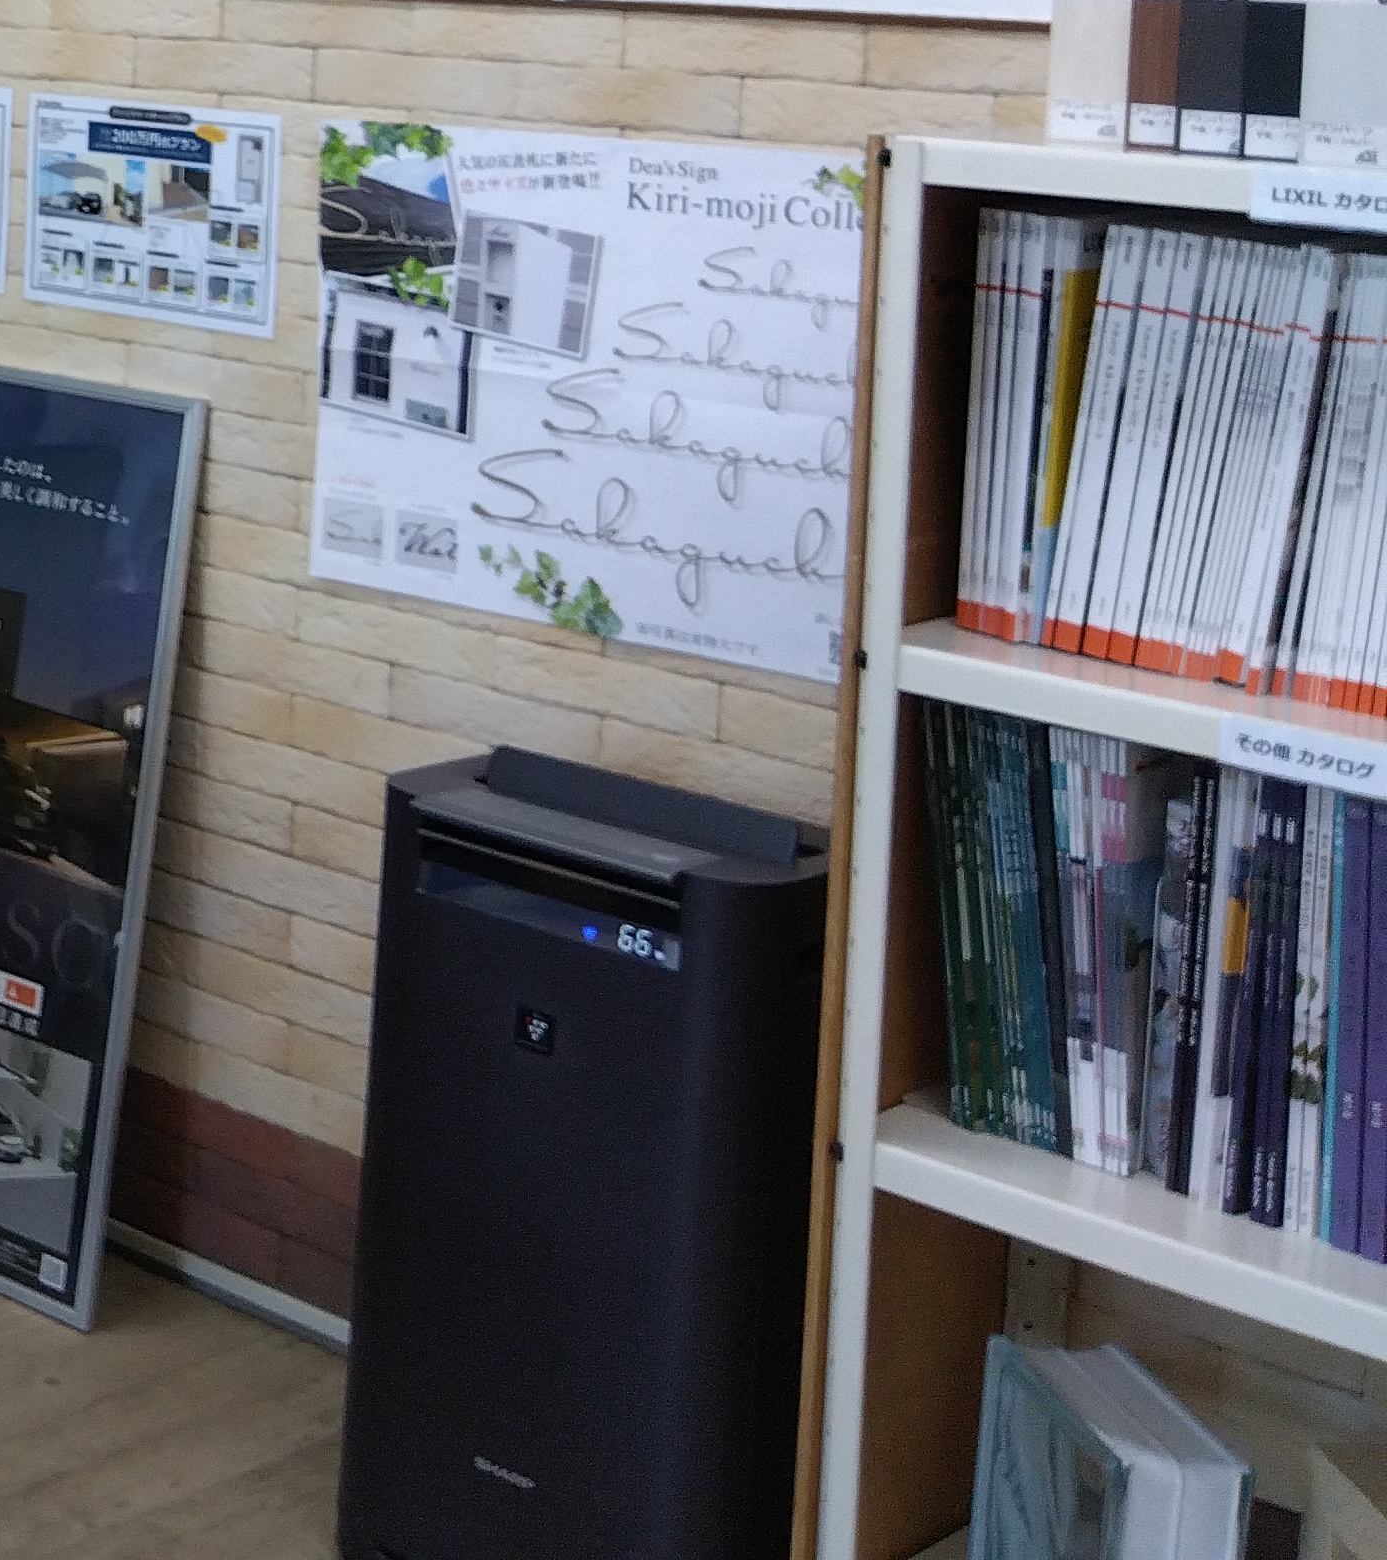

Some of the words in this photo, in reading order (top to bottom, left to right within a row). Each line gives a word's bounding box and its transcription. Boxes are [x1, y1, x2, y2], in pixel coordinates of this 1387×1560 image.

[677, 161, 720, 182] Sign
[627, 180, 778, 232] Kiri-moji
[1272, 186, 1327, 207] LIXIL
[1238, 733, 1289, 762] その他
[1298, 748, 1375, 780] カタログ
[617, 924, 653, 958] 66
